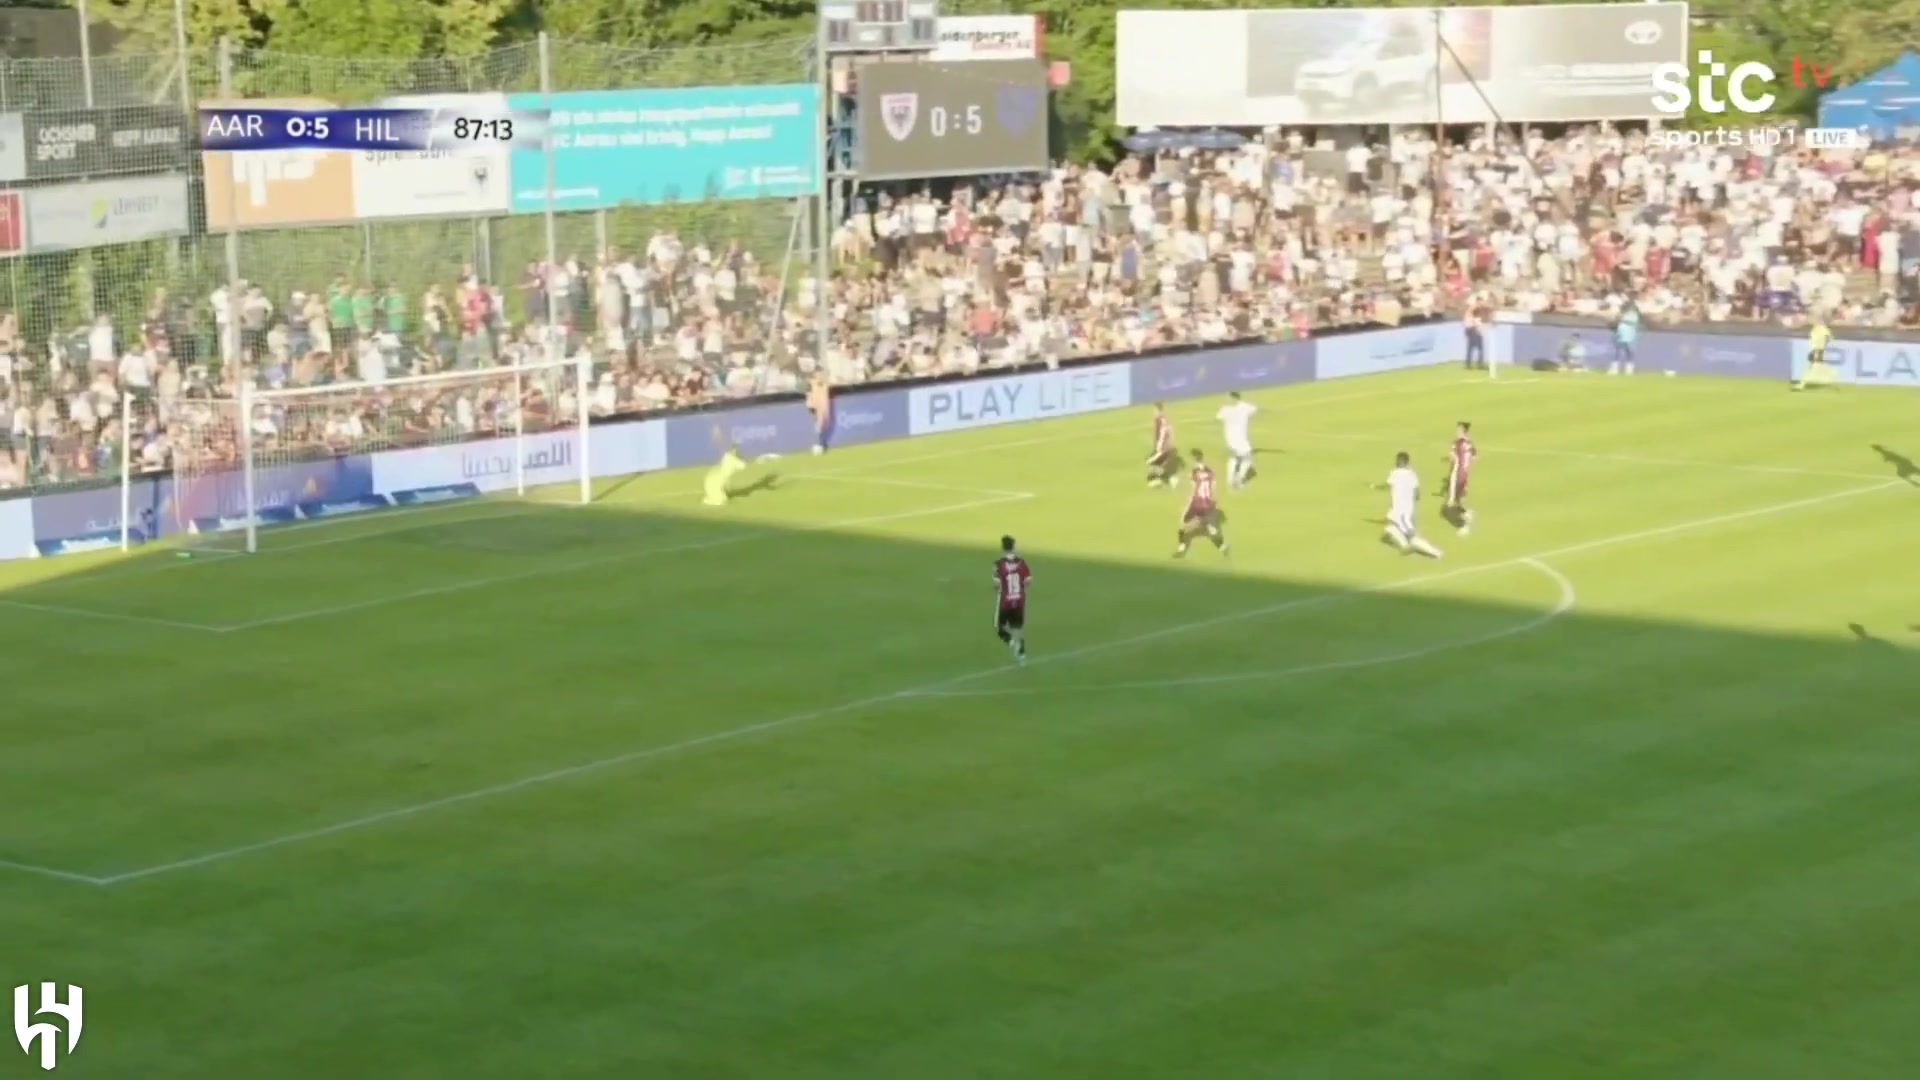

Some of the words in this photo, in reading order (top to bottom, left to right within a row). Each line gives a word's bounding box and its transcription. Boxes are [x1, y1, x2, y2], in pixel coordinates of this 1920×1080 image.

[37, 143, 76, 160] SPORT
[929, 383, 1023, 425] PLAY
[1039, 371, 1112, 411] LIFE
